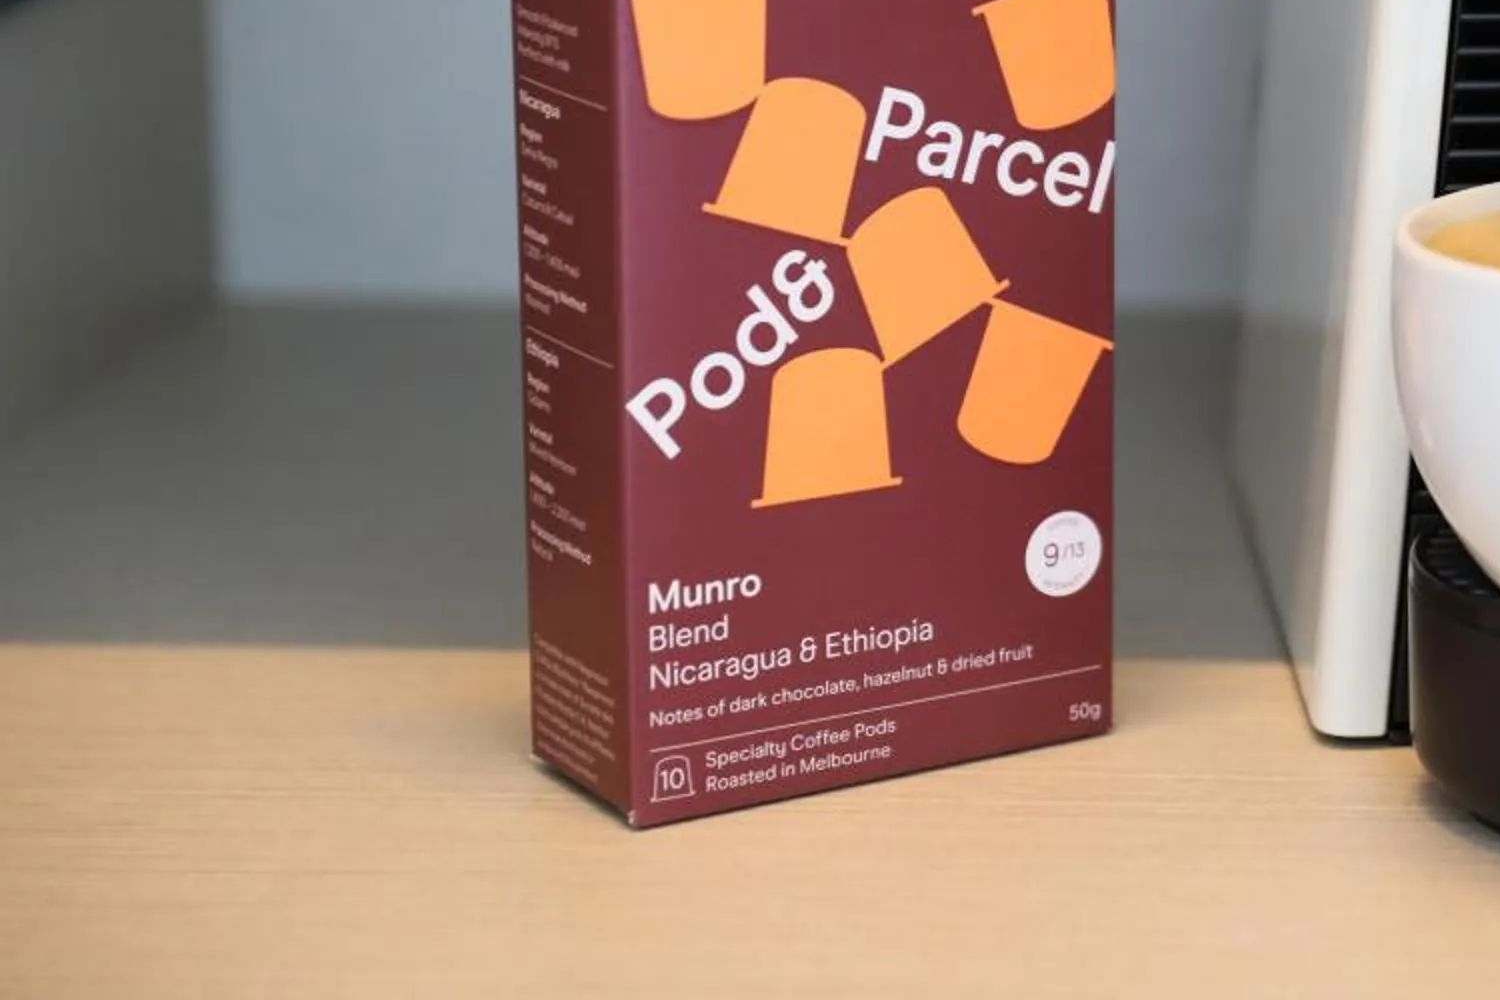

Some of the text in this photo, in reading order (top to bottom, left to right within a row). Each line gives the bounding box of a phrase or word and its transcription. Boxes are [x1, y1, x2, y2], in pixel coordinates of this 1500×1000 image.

[865, 86, 1115, 214] Parcel
[648, 574, 762, 613] Munro
[649, 615, 729, 652] Blend
[650, 617, 934, 690] Nicaragua & Ethiopia
[650, 644, 1034, 728] Notes of dark chocolate, hazelnut & dried fruit
[1069, 701, 1101, 721] 50g
[706, 717, 896, 769] Specialty Coffee Pods
[659, 767, 685, 790] 10
[706, 744, 891, 791] Roasted in Melbourne
